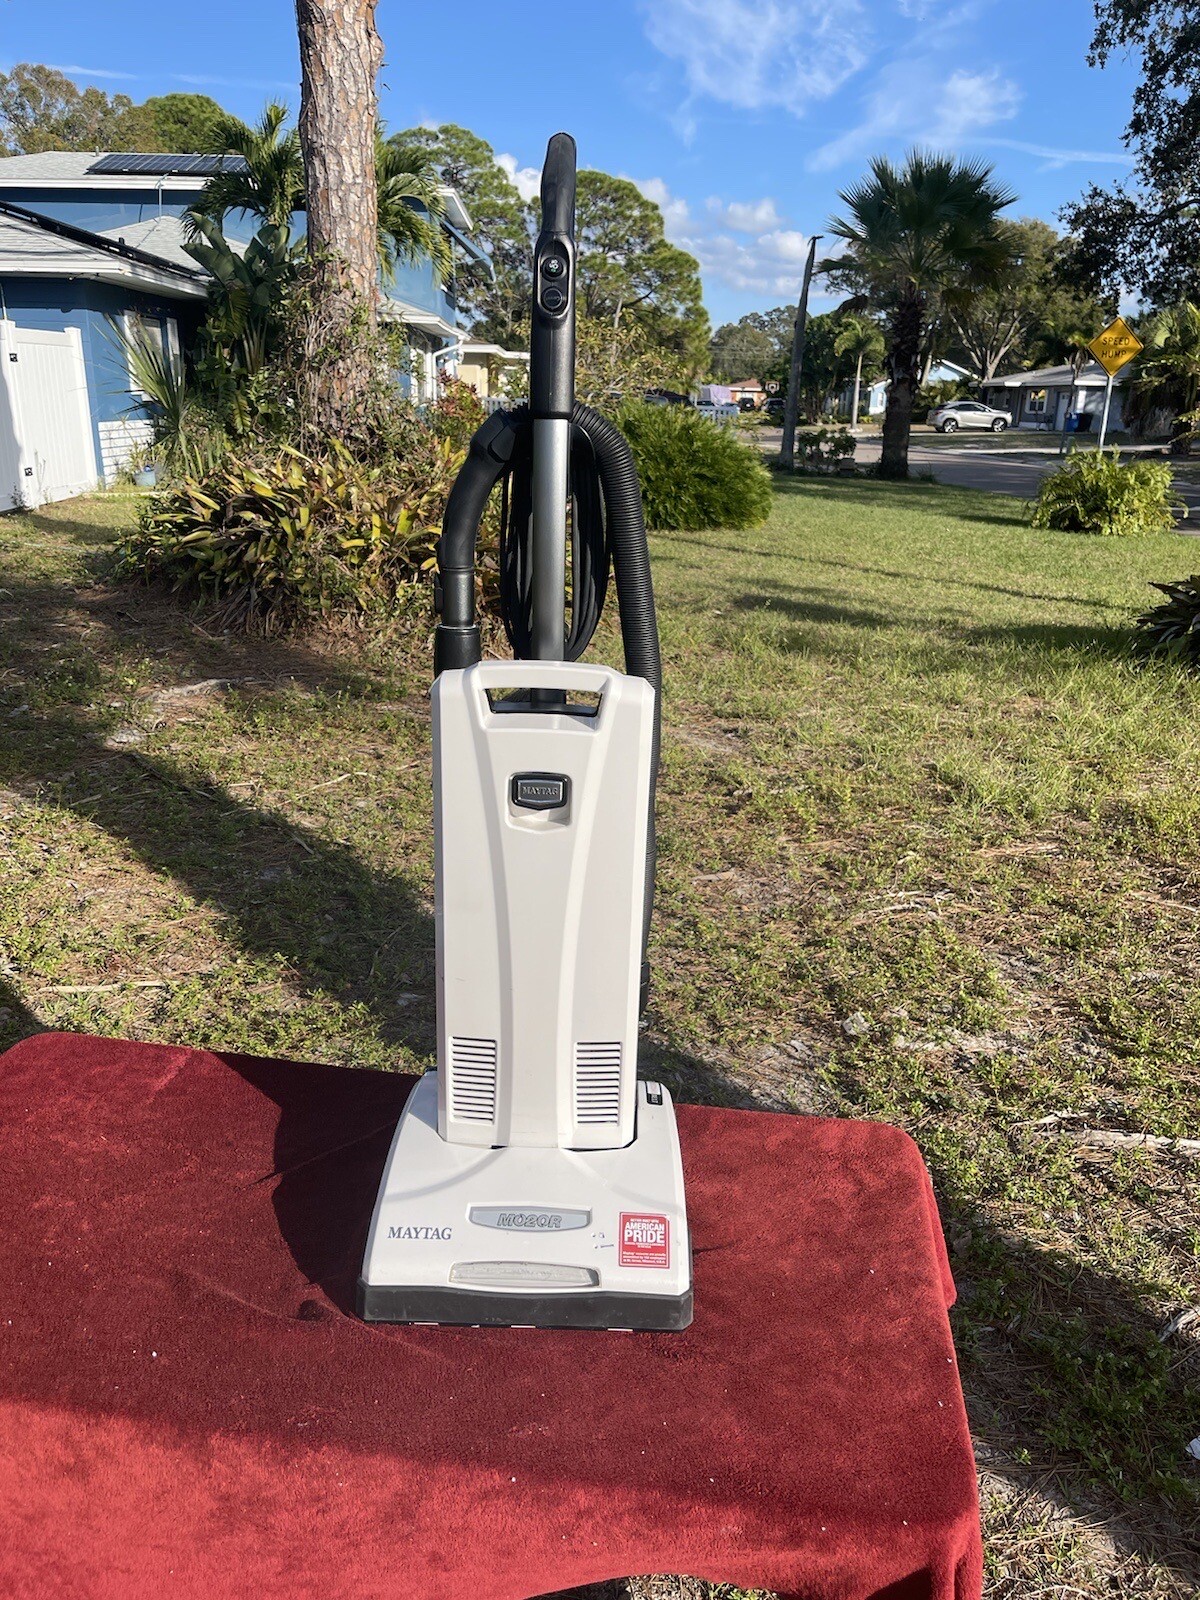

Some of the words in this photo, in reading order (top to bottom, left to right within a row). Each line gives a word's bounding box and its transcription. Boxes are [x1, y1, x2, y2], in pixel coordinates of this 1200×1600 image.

[1102, 336, 1130, 346] SPEED
[1101, 350, 1127, 359] HUMP
[522, 786, 558, 795] MAYTAG
[625, 1221, 665, 1232] AMERICAN
[387, 1226, 452, 1240] MAYTAG
[624, 1229, 665, 1243] PRIDE
